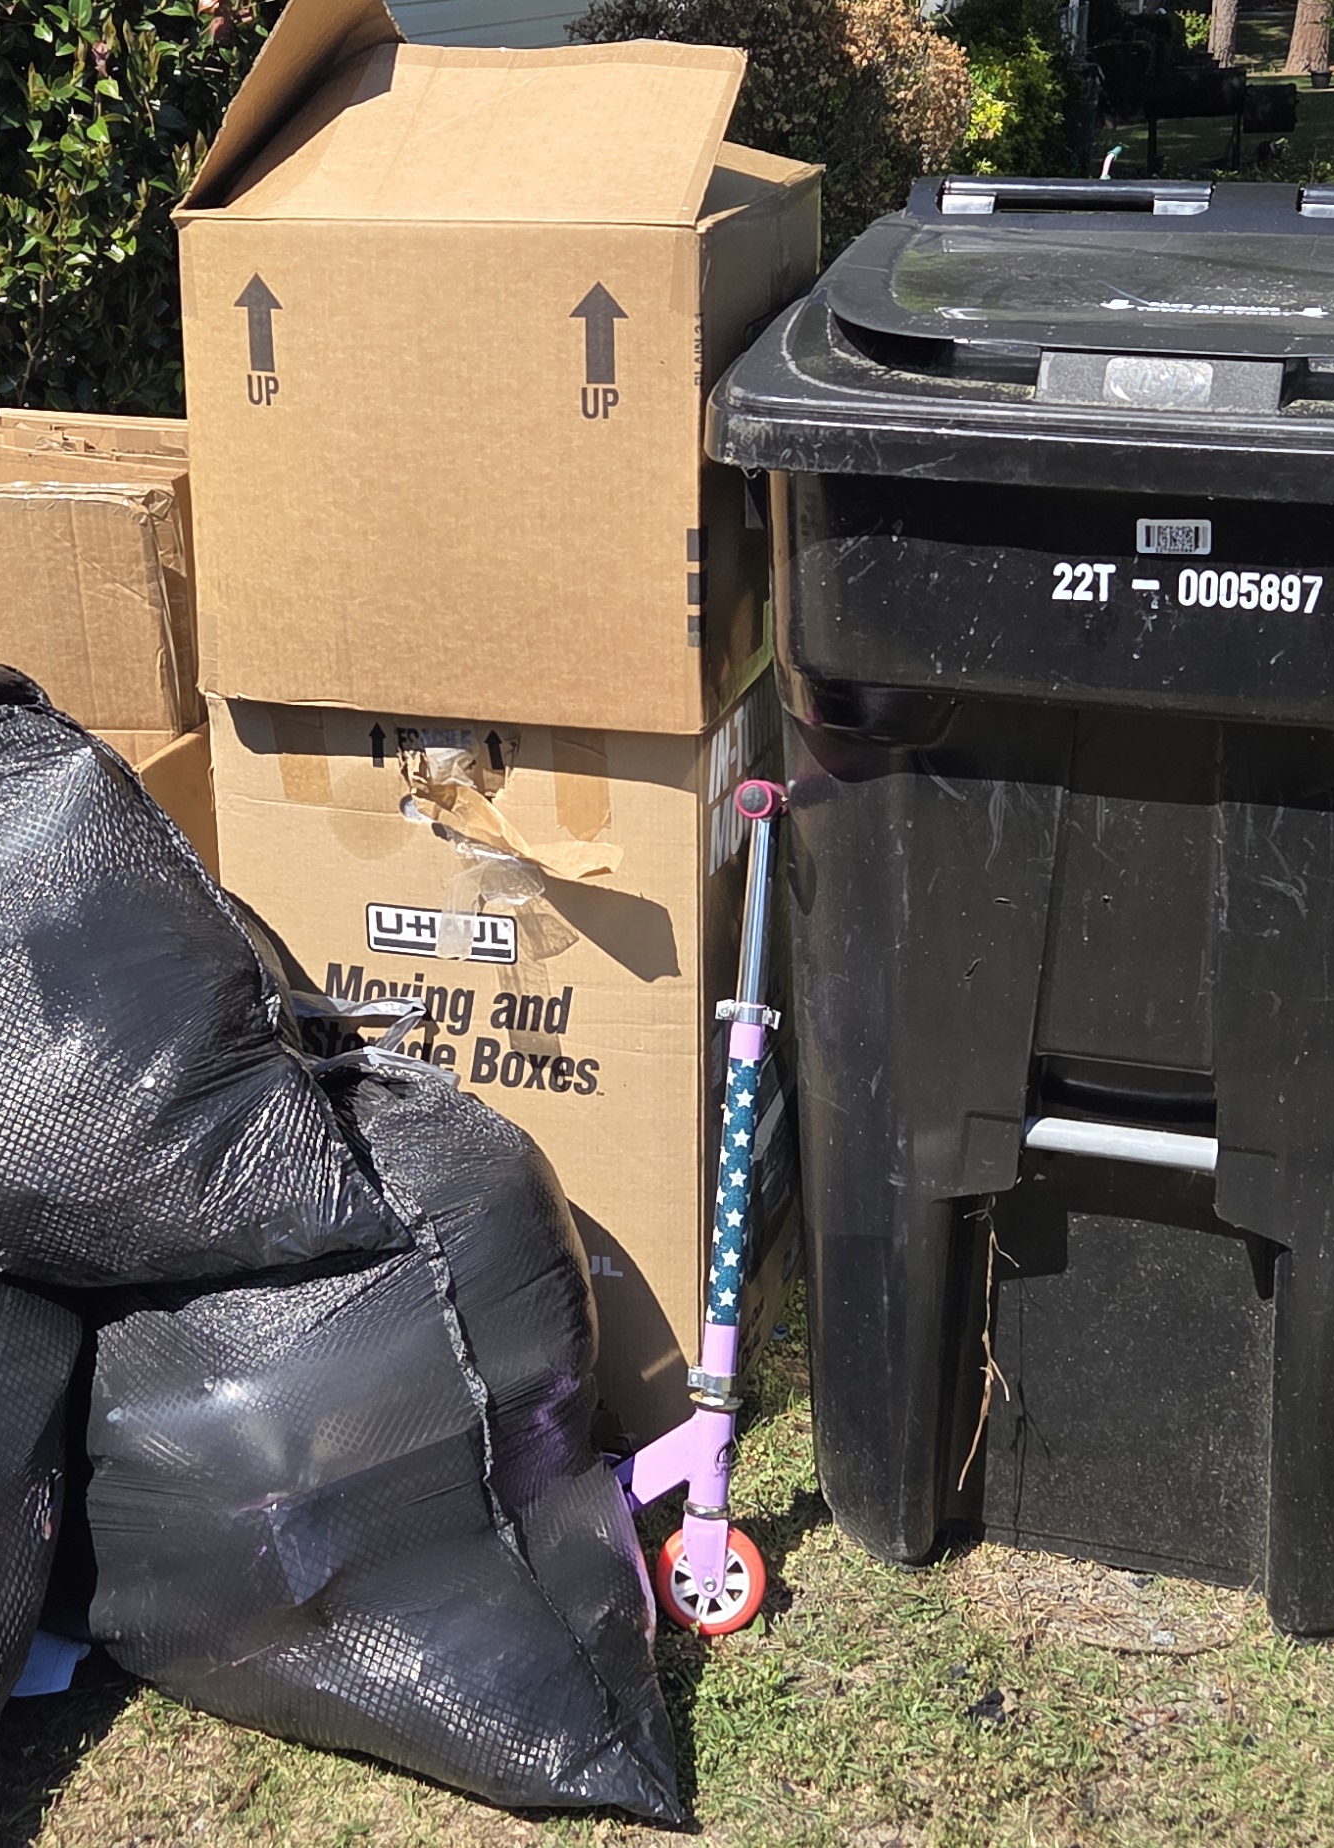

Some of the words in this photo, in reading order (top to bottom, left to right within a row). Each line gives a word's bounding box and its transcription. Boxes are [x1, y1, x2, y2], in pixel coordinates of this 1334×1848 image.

[247, 374, 279, 406] UP
[581, 387, 619, 419] UP
[1052, 562, 1117, 602] 22T
[1177, 569, 1324, 614] 0005897
[489, 986, 573, 1035] and
[470, 1036, 600, 1096] Boxes
